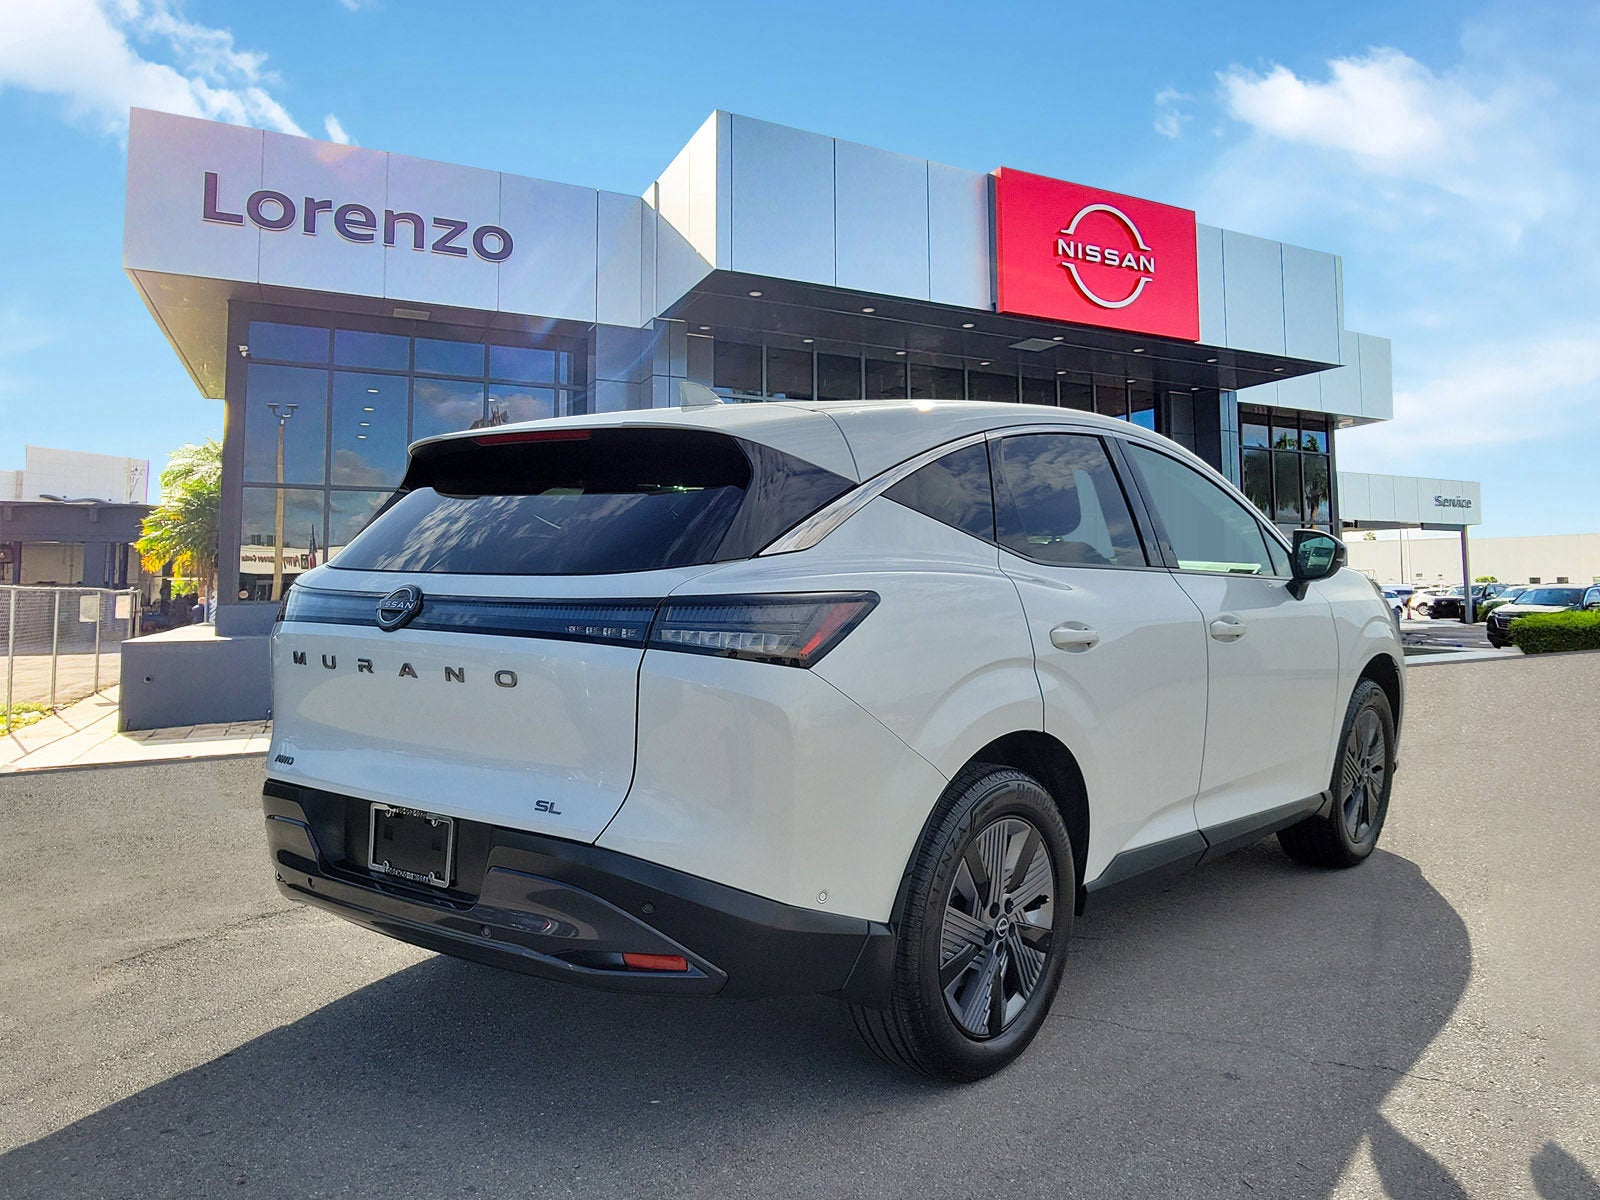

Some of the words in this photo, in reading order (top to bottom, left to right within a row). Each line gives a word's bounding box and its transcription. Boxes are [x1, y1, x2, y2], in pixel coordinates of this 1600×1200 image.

[202, 171, 514, 262] Lorenzo
[1057, 238, 1155, 273] NISSAN
[1434, 495, 1472, 508] Service
[379, 599, 415, 609] SSAN
[292, 650, 518, 688] MURANO
[534, 799, 562, 815] SL
[928, 826, 970, 911] ALENZA
